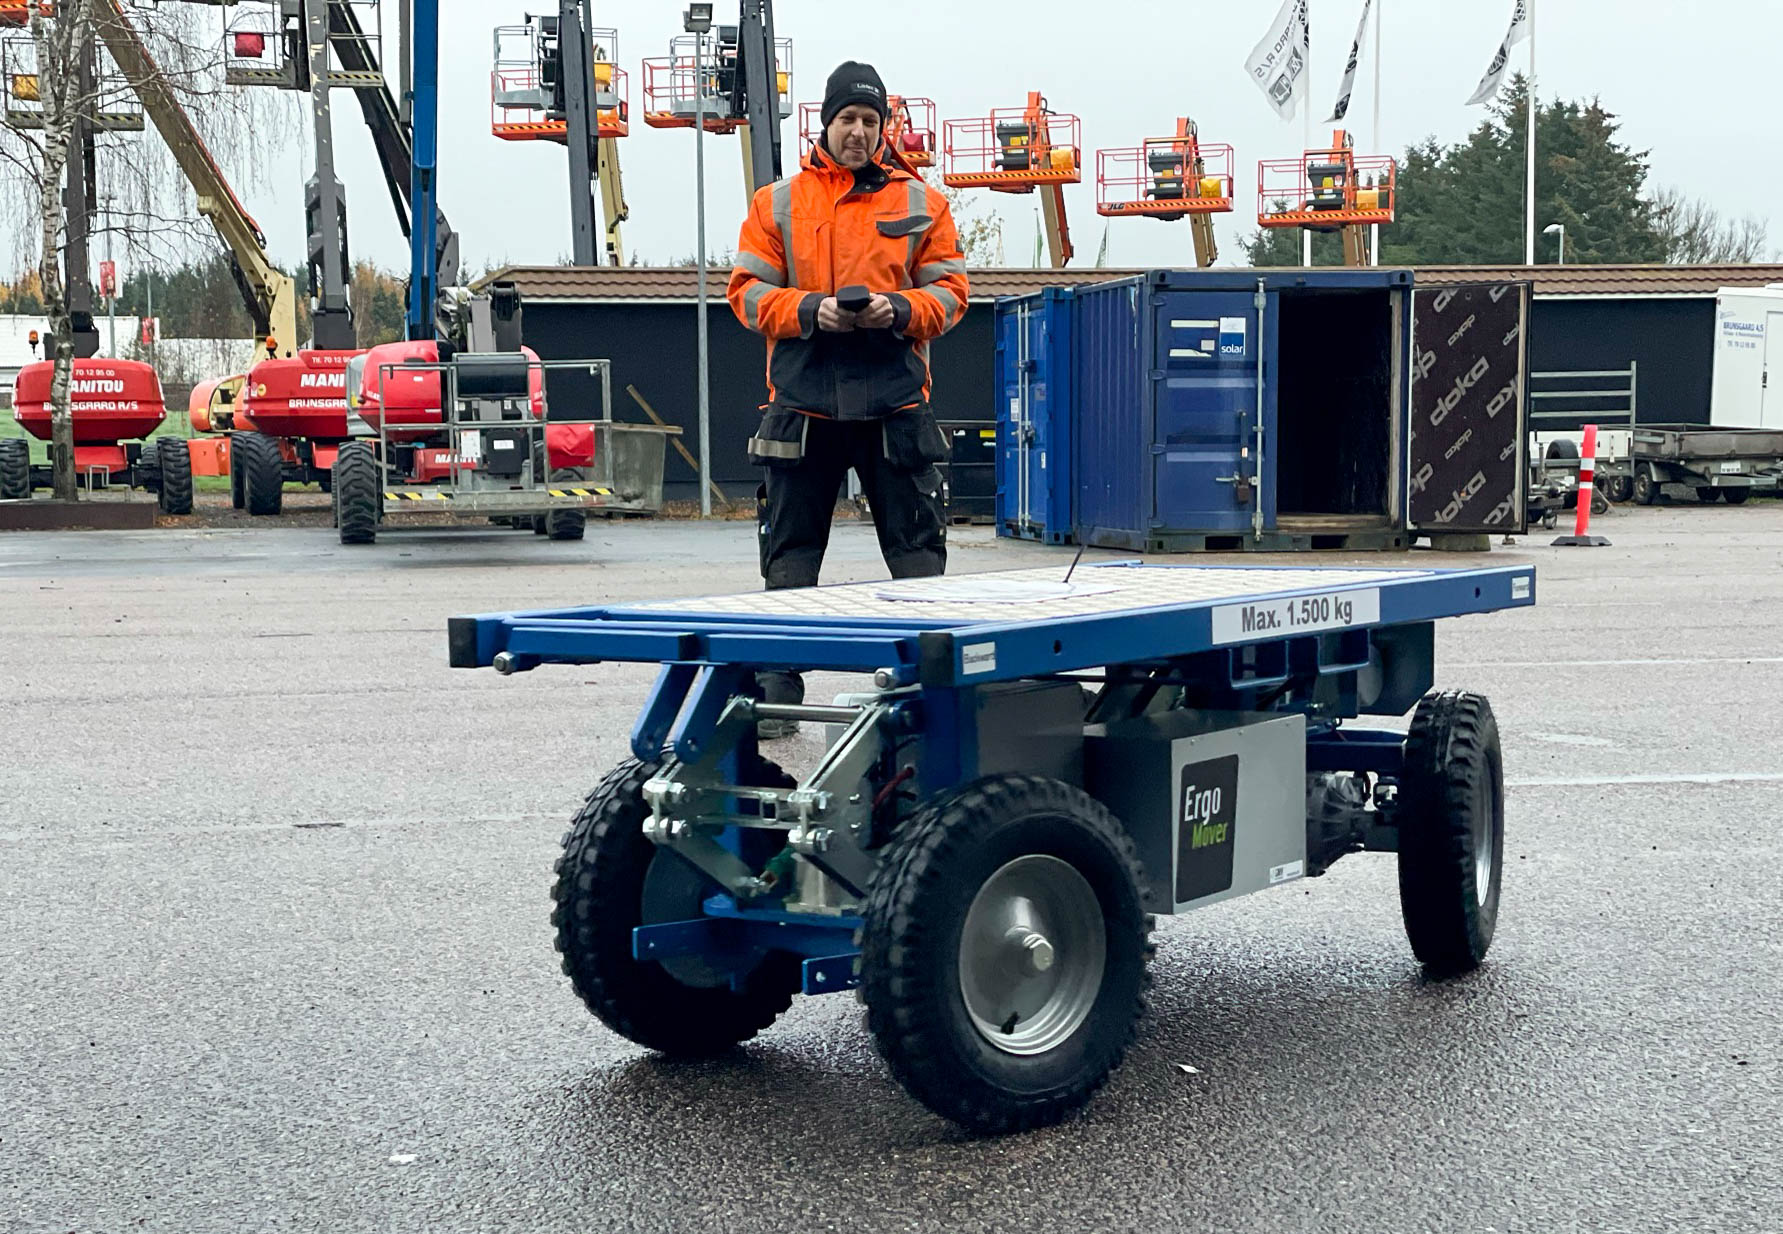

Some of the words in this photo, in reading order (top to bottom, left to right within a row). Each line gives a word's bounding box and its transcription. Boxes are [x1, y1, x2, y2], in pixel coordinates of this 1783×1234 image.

[1221, 344, 1243, 353] solar
[70, 379, 124, 393] ANITOU
[300, 373, 345, 388] MANI
[1430, 355, 1490, 427] doka
[1242, 605, 1281, 633] Max.
[1287, 597, 1329, 626] 1.500
[1334, 596, 1352, 625] kg
[1184, 784, 1221, 826] Ergo
[1191, 822, 1229, 850] Mover
